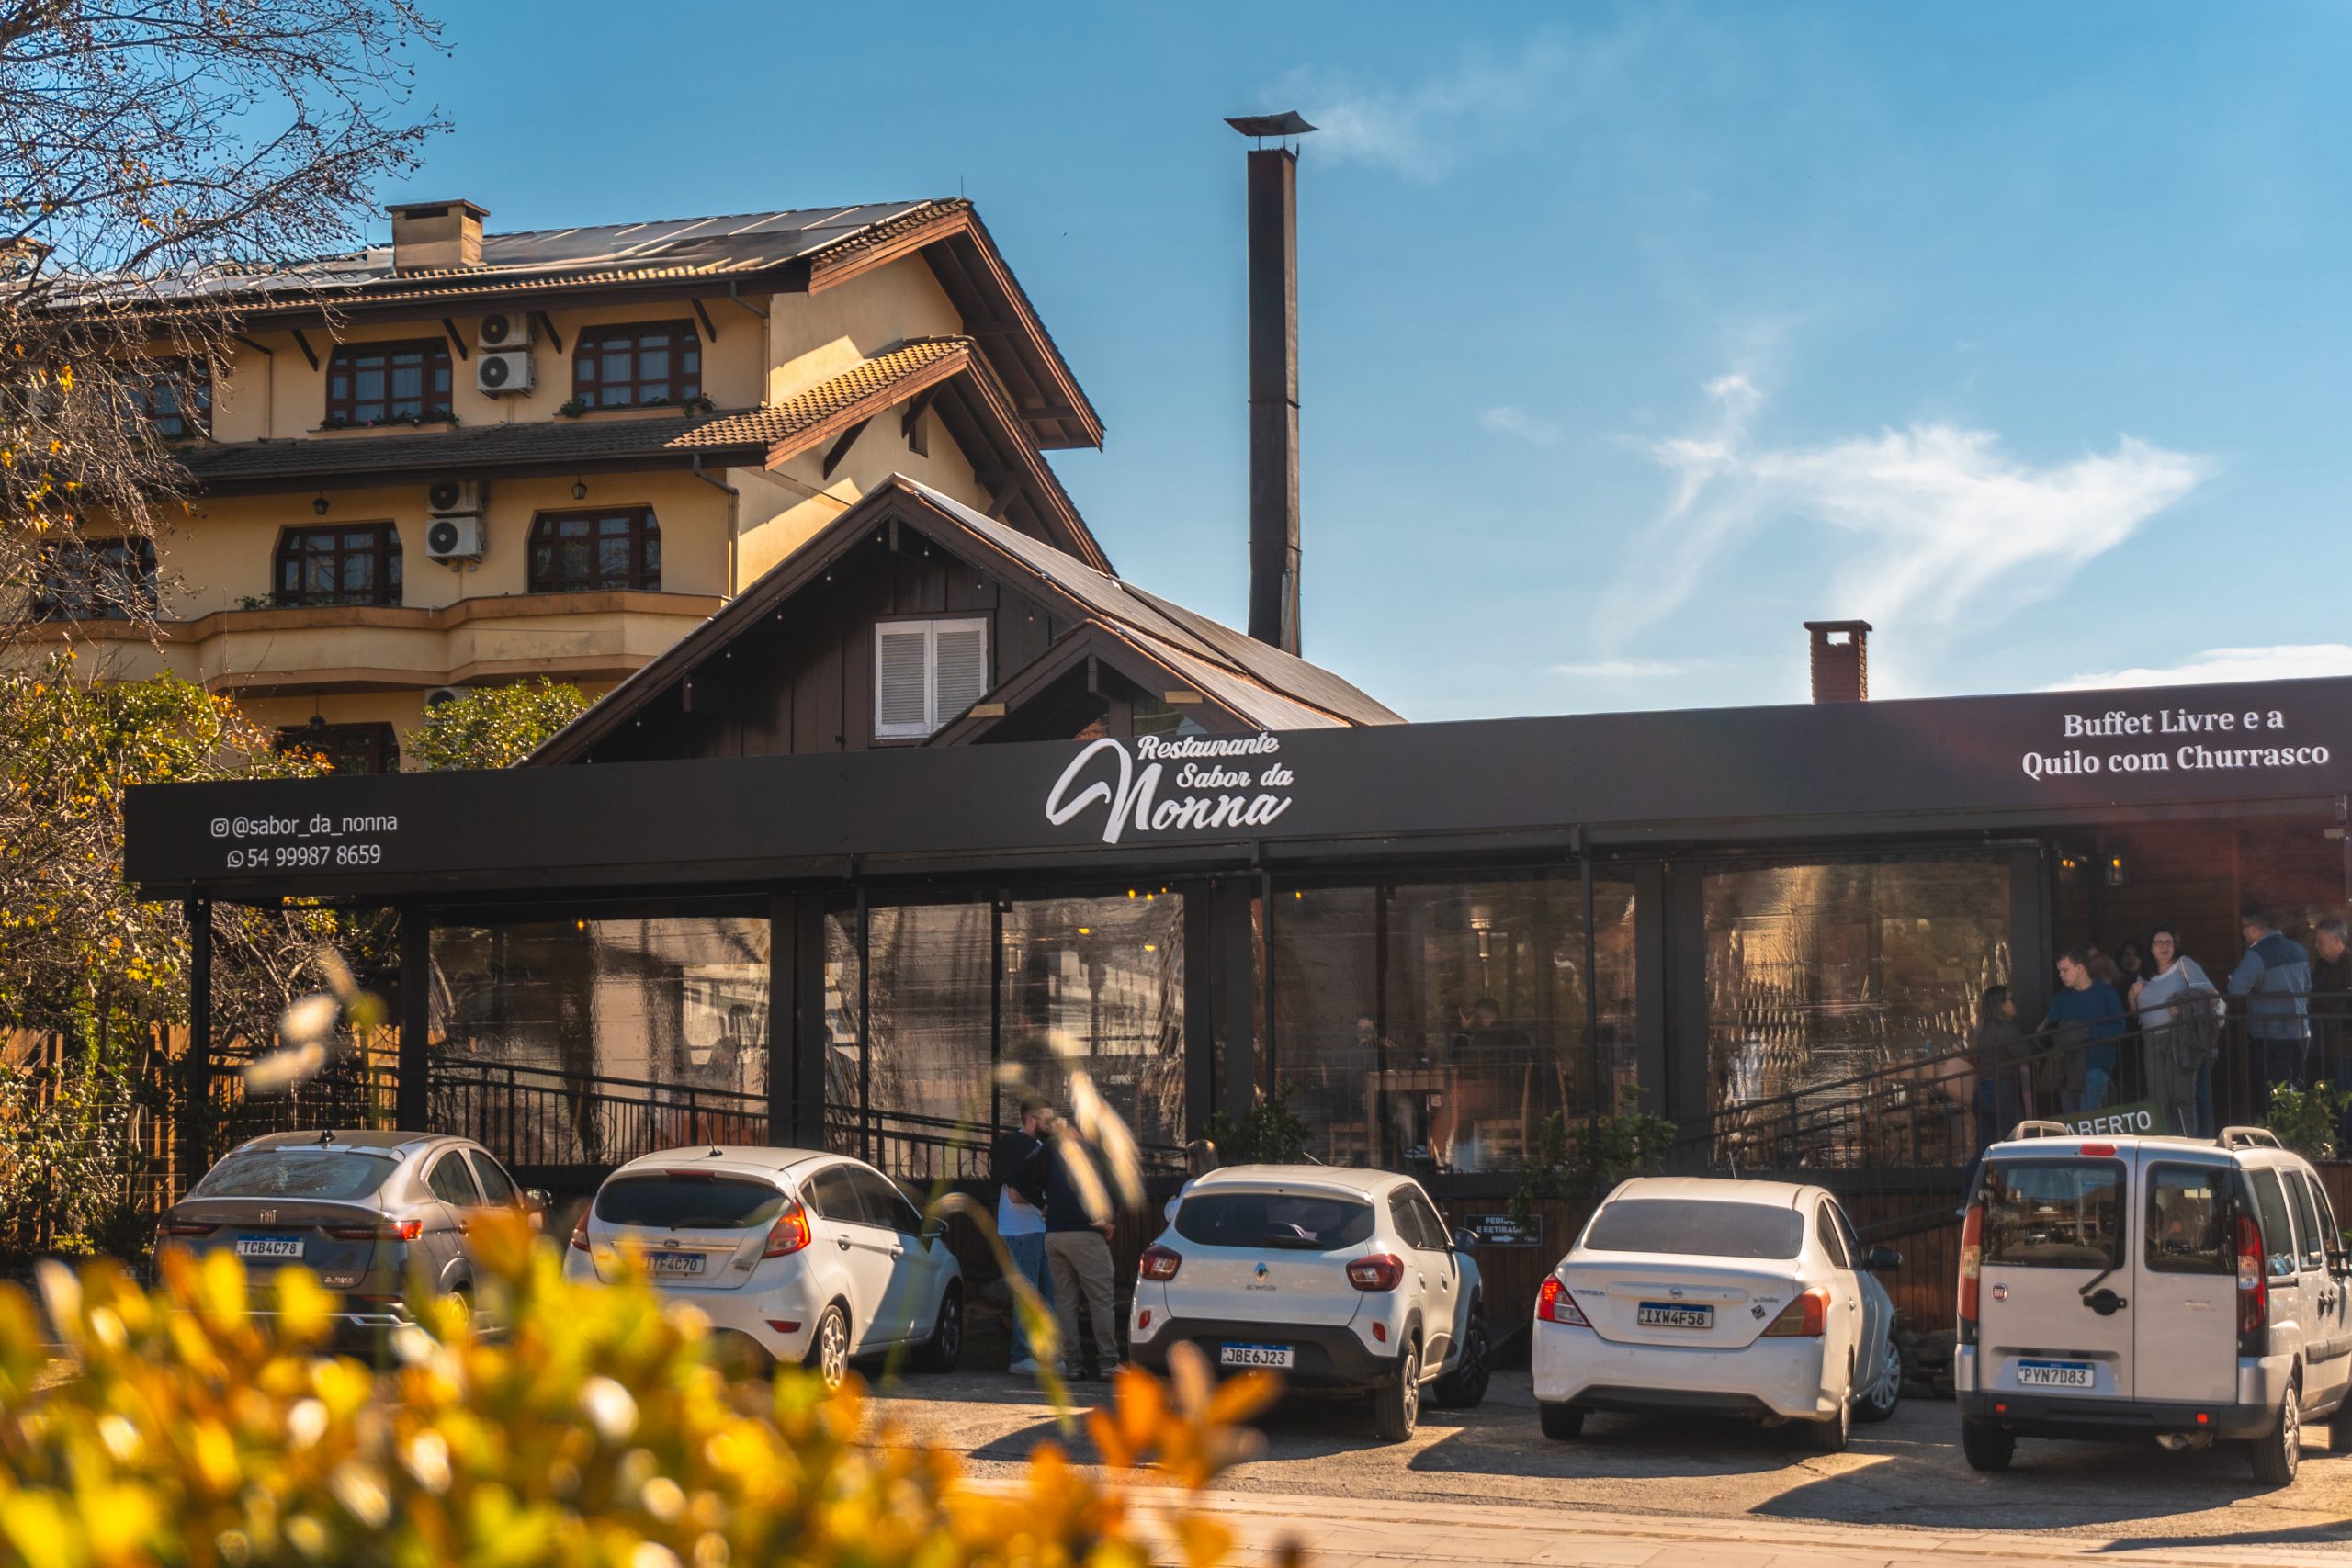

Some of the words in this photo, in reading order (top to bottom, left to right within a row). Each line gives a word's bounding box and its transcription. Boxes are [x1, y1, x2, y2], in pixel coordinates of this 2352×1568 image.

[2064, 711, 2153, 737] Buffet
[2160, 708, 2234, 733] Livre
[2243, 710, 2258, 728] e
[2267, 710, 2285, 728] a
[1137, 732, 1280, 760] Restaurante
[1176, 763, 1251, 788] Sabor
[1260, 762, 1295, 786] da
[2021, 750, 2099, 780] Quilo
[2108, 750, 2169, 773] com
[2177, 745, 2330, 770] Churrasco
[1046, 737, 1293, 844] Nonna
[232, 813, 398, 838] @sabor_da_nonna
[247, 848, 269, 867] 54
[275, 846, 330, 866] 99987
[336, 844, 381, 864] 8659
[2065, 1111, 2153, 1136] ABERTO
[1485, 1216, 1516, 1224] PEDI
[243, 1242, 297, 1255] TCB4C78
[1644, 1309, 1705, 1325] IXW4F58
[1227, 1348, 1286, 1365] JBE6J23
[2023, 1368, 2086, 1385] PYN7D83
